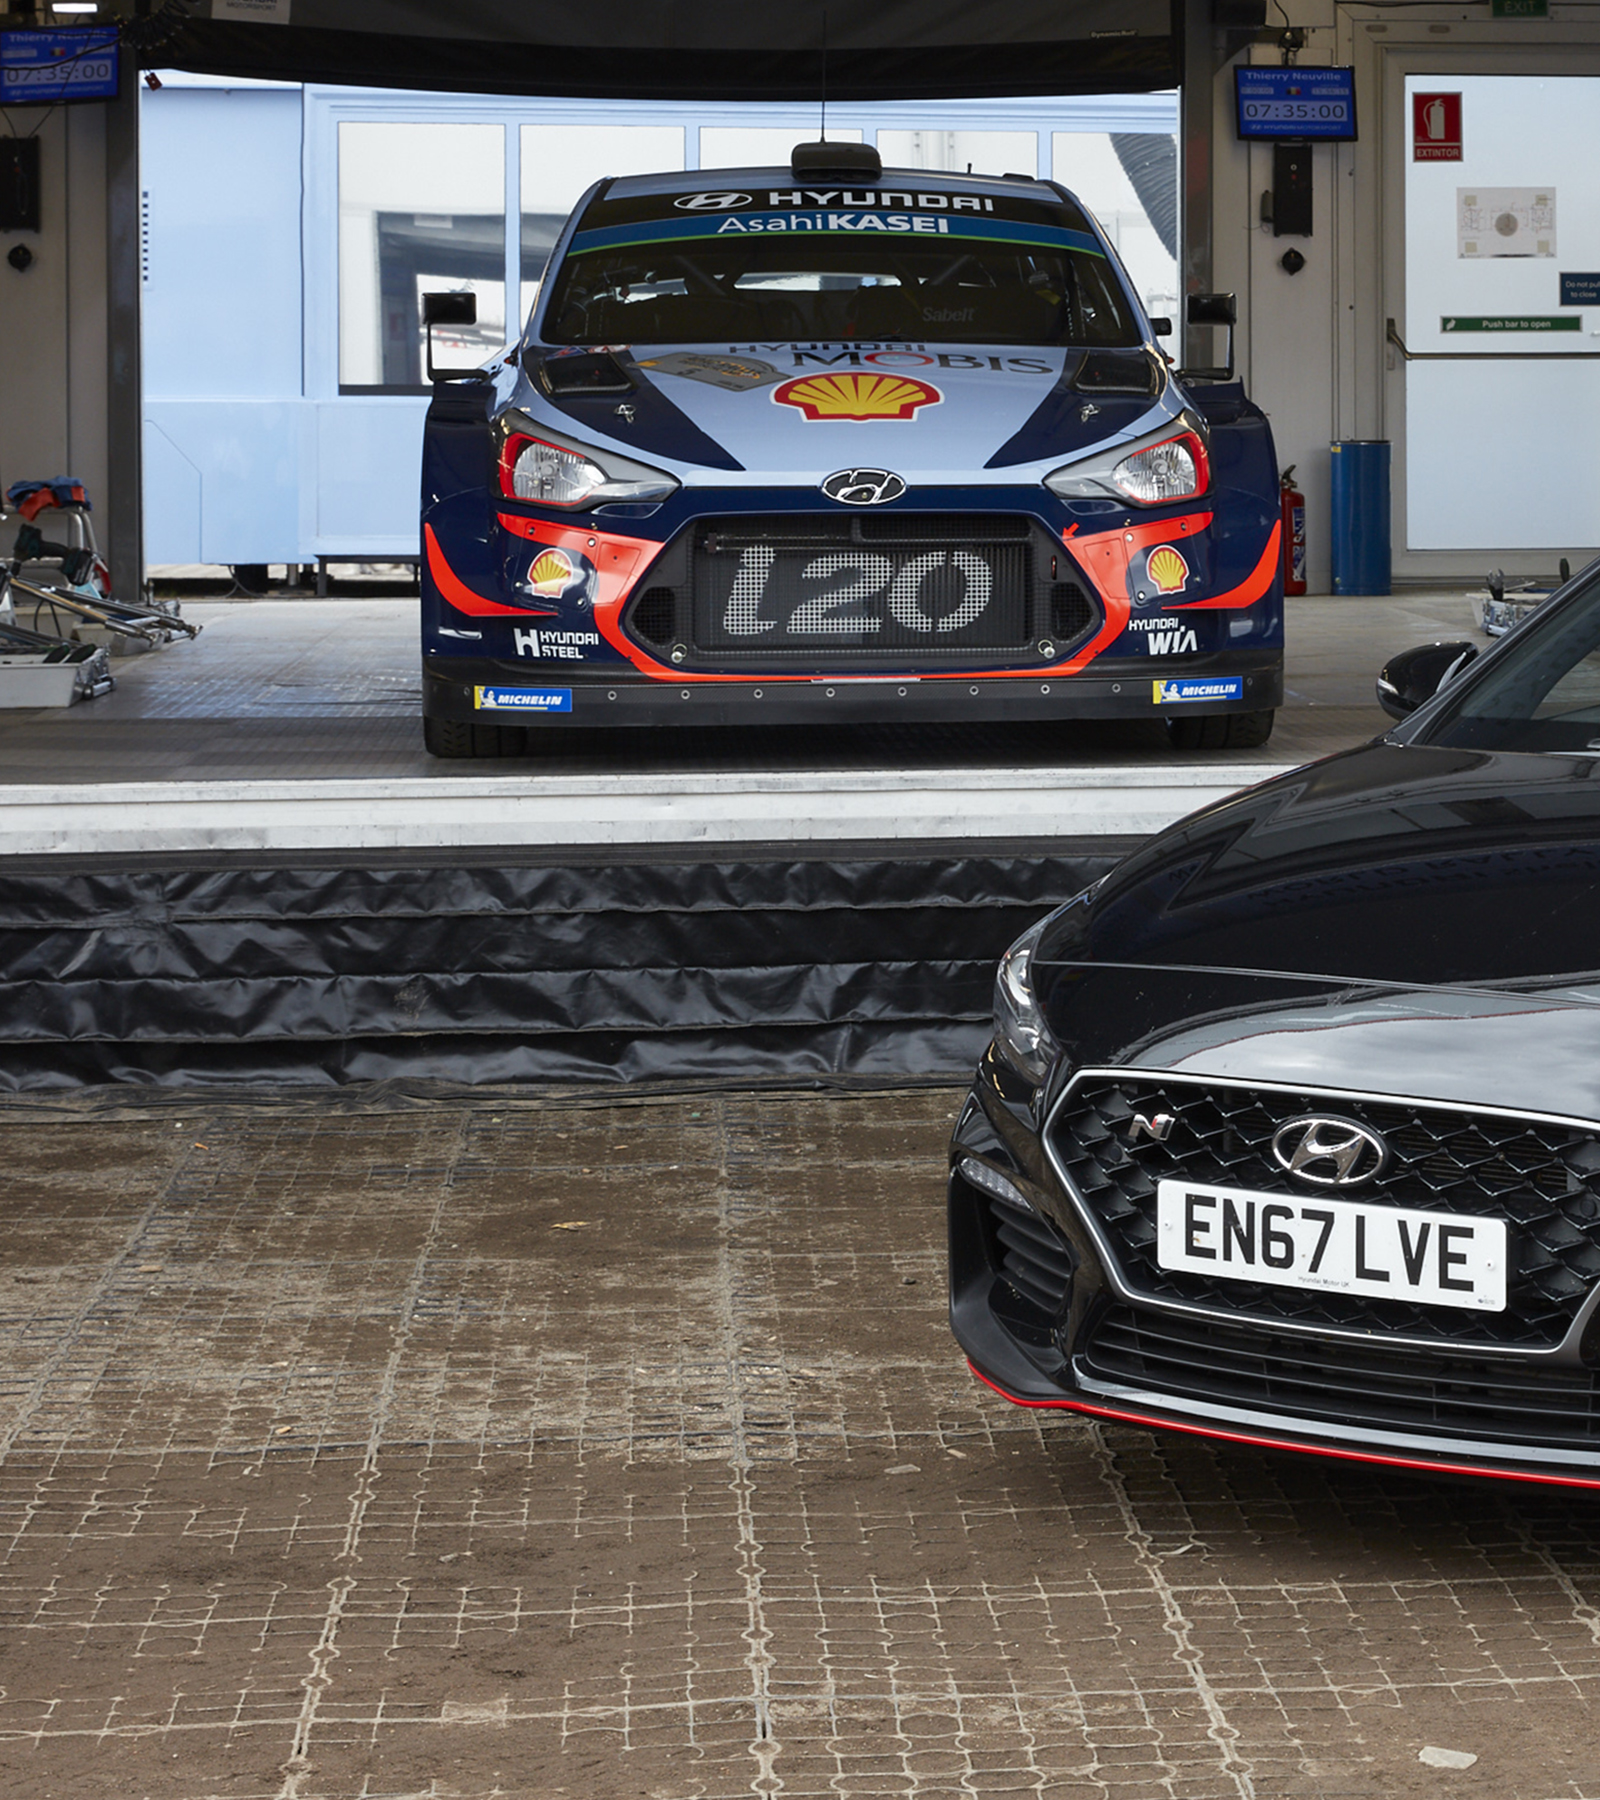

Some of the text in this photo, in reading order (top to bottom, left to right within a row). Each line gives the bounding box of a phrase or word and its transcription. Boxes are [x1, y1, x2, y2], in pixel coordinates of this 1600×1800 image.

[1504, 1, 1536, 13] EXIT
[9, 33, 55, 43] Thierry
[1245, 72, 1341, 82] Thierry Neuville
[1245, 103, 1345, 119] 07:35:00
[1416, 148, 1460, 158] EXTINTOR
[768, 190, 995, 212] HYUNDAI
[1565, 281, 1576, 289] Do
[1576, 281, 1589, 289] not
[922, 306, 975, 323] Sabelt
[1482, 320, 1551, 330] Push bar to open
[792, 351, 1054, 375] MOBIS
[723, 544, 993, 636] i20
[1128, 617, 1179, 631] HYUNDAI
[539, 631, 599, 646] HYUNDAI
[1147, 625, 1198, 656] WIA
[541, 645, 584, 659] STEEL
[1181, 684, 1238, 697] MICHELIN
[497, 694, 563, 706] MICHELIN
[1183, 1193, 1475, 1293] EN67 LVE
[1298, 1276, 1322, 1285] Hyundai
[1323, 1278, 1340, 1287] Motor
